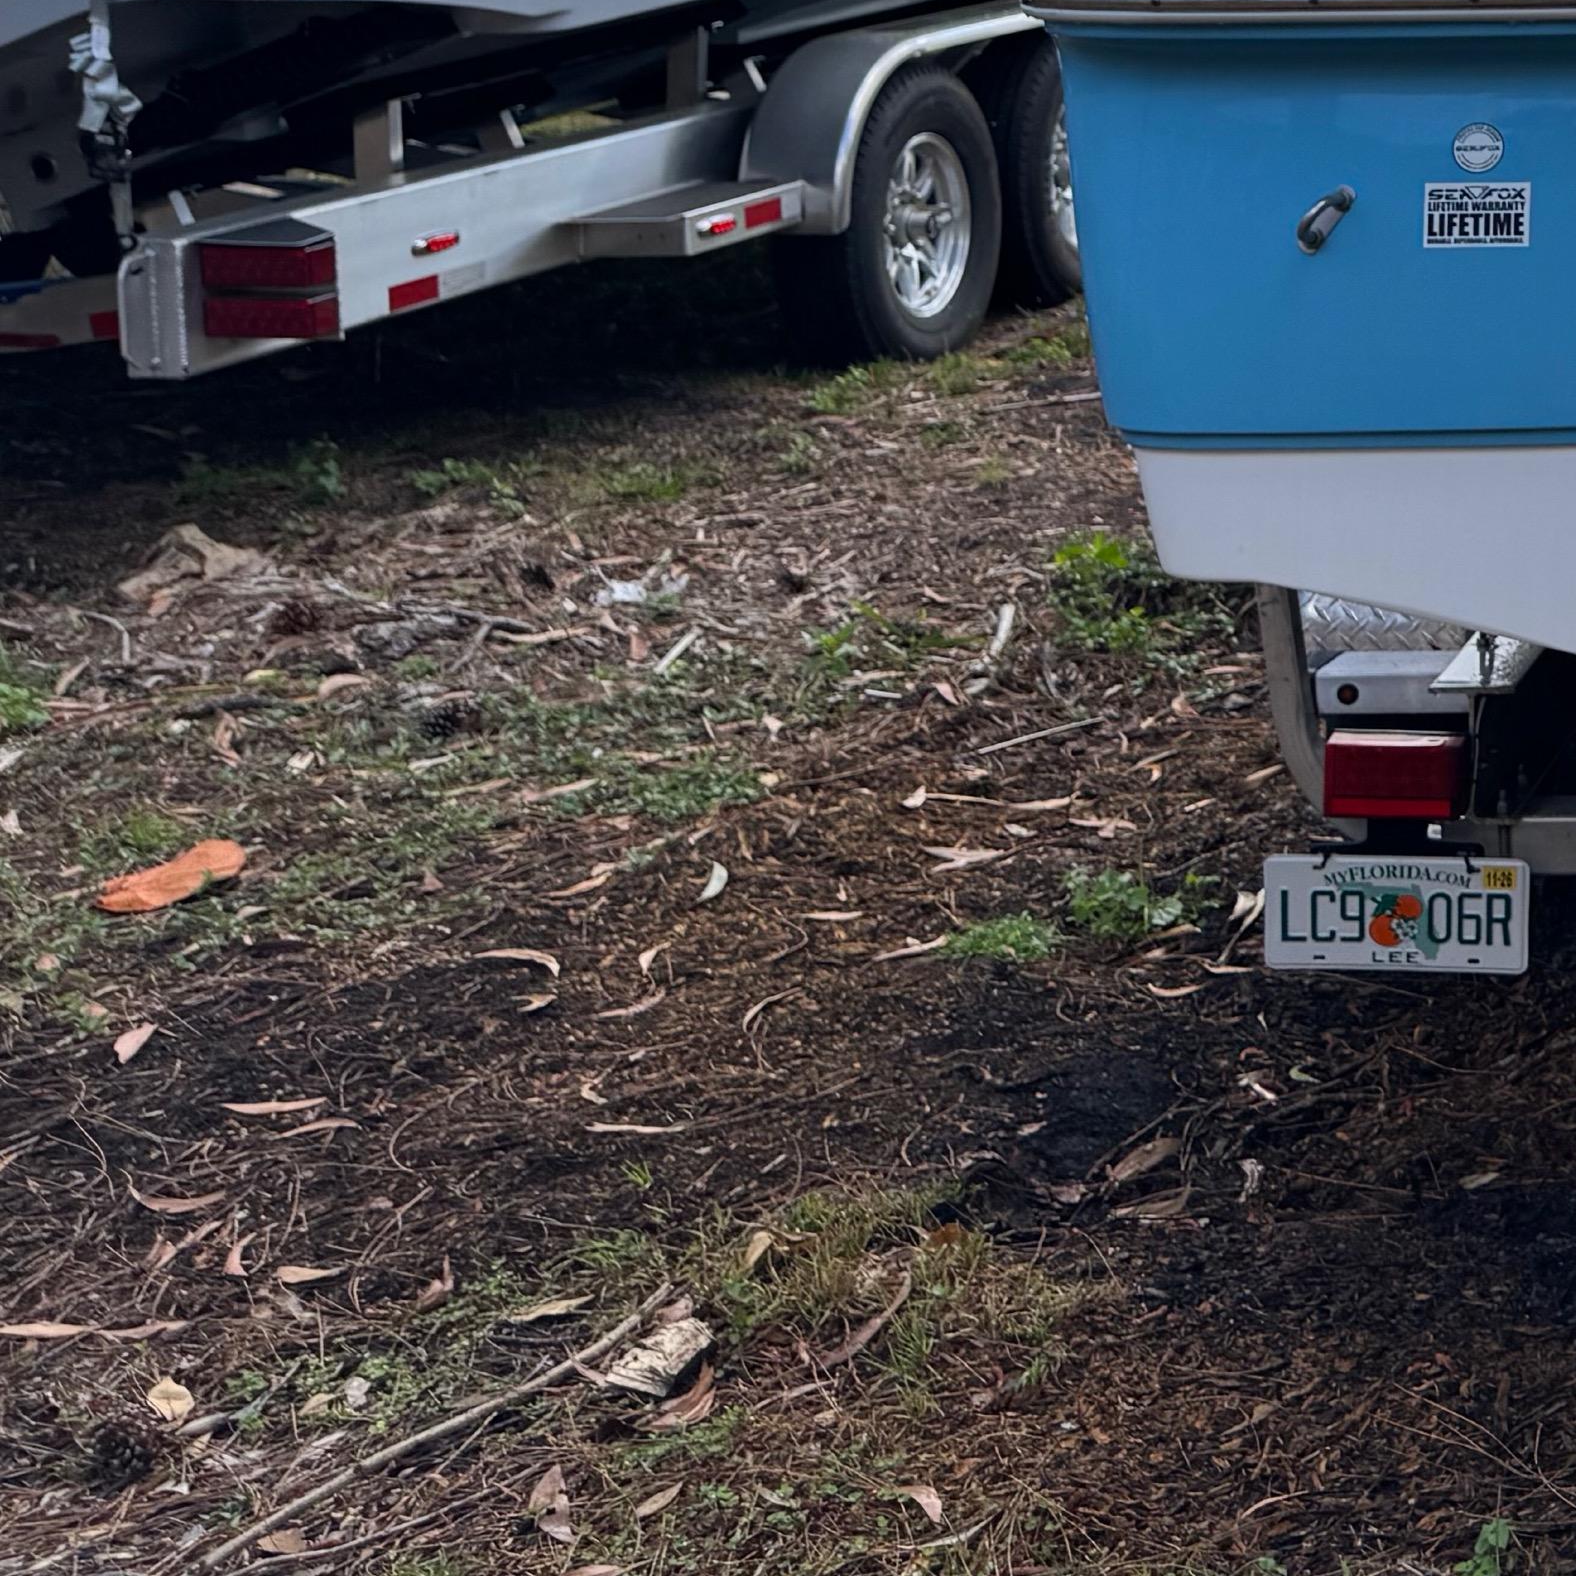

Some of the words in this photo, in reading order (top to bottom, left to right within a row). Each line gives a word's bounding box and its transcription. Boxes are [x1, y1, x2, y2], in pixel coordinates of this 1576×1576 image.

[1428, 201, 1468, 211] LIFETIME
[1471, 201, 1525, 211] WARRANTY
[1427, 213, 1524, 236] LIFETIME
[1324, 864, 1471, 889] MYFLORIDA.COM
[1281, 890, 1365, 942] LC9
[1372, 951, 1420, 963] LEE
